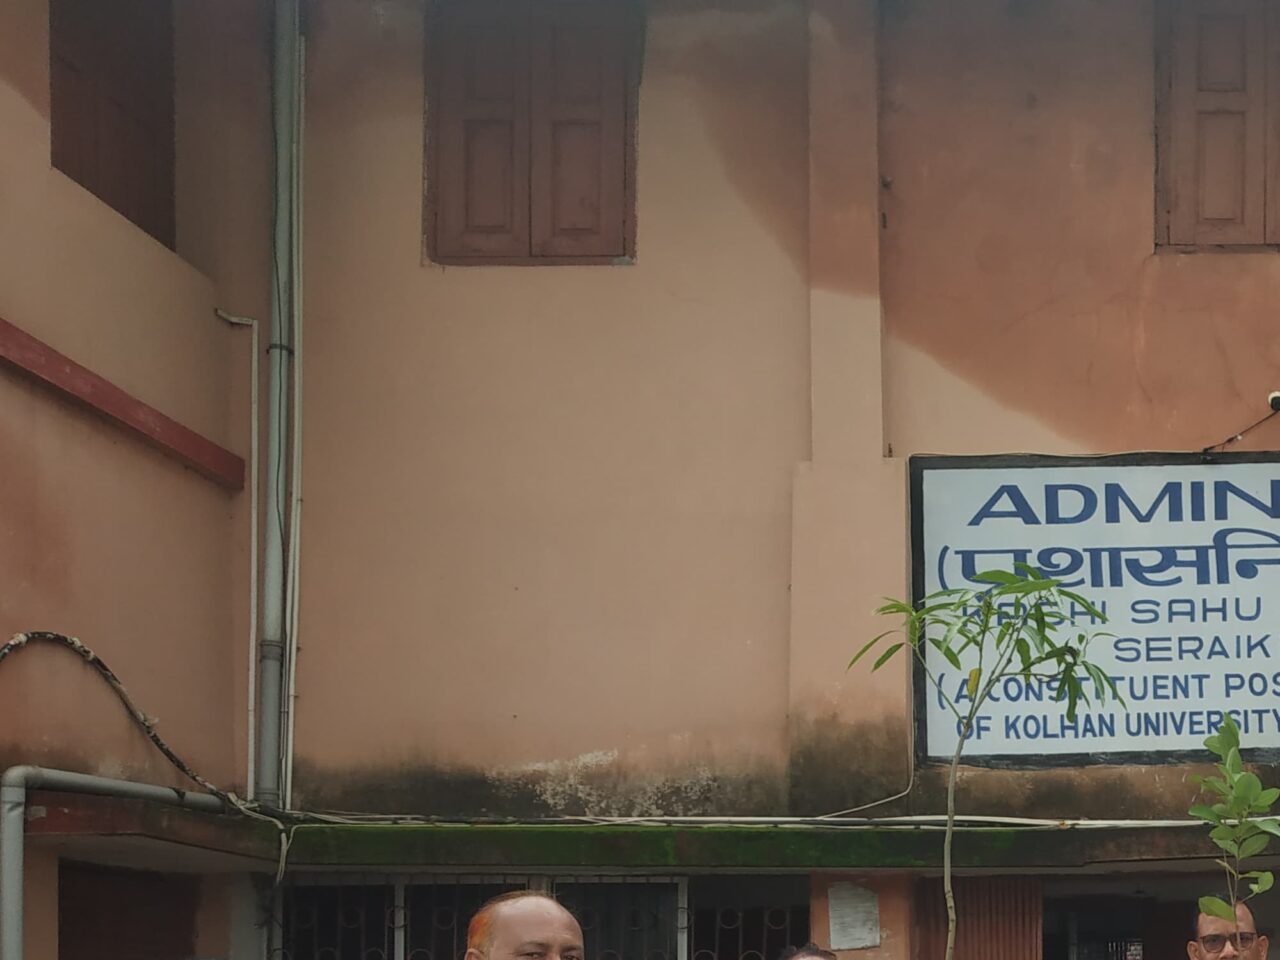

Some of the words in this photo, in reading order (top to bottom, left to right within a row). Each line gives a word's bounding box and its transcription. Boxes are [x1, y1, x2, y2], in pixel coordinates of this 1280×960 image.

[1130, 597, 1262, 625] SAHU
[956, 715, 992, 740] OF
[1004, 713, 1115, 740] KOLHAN
